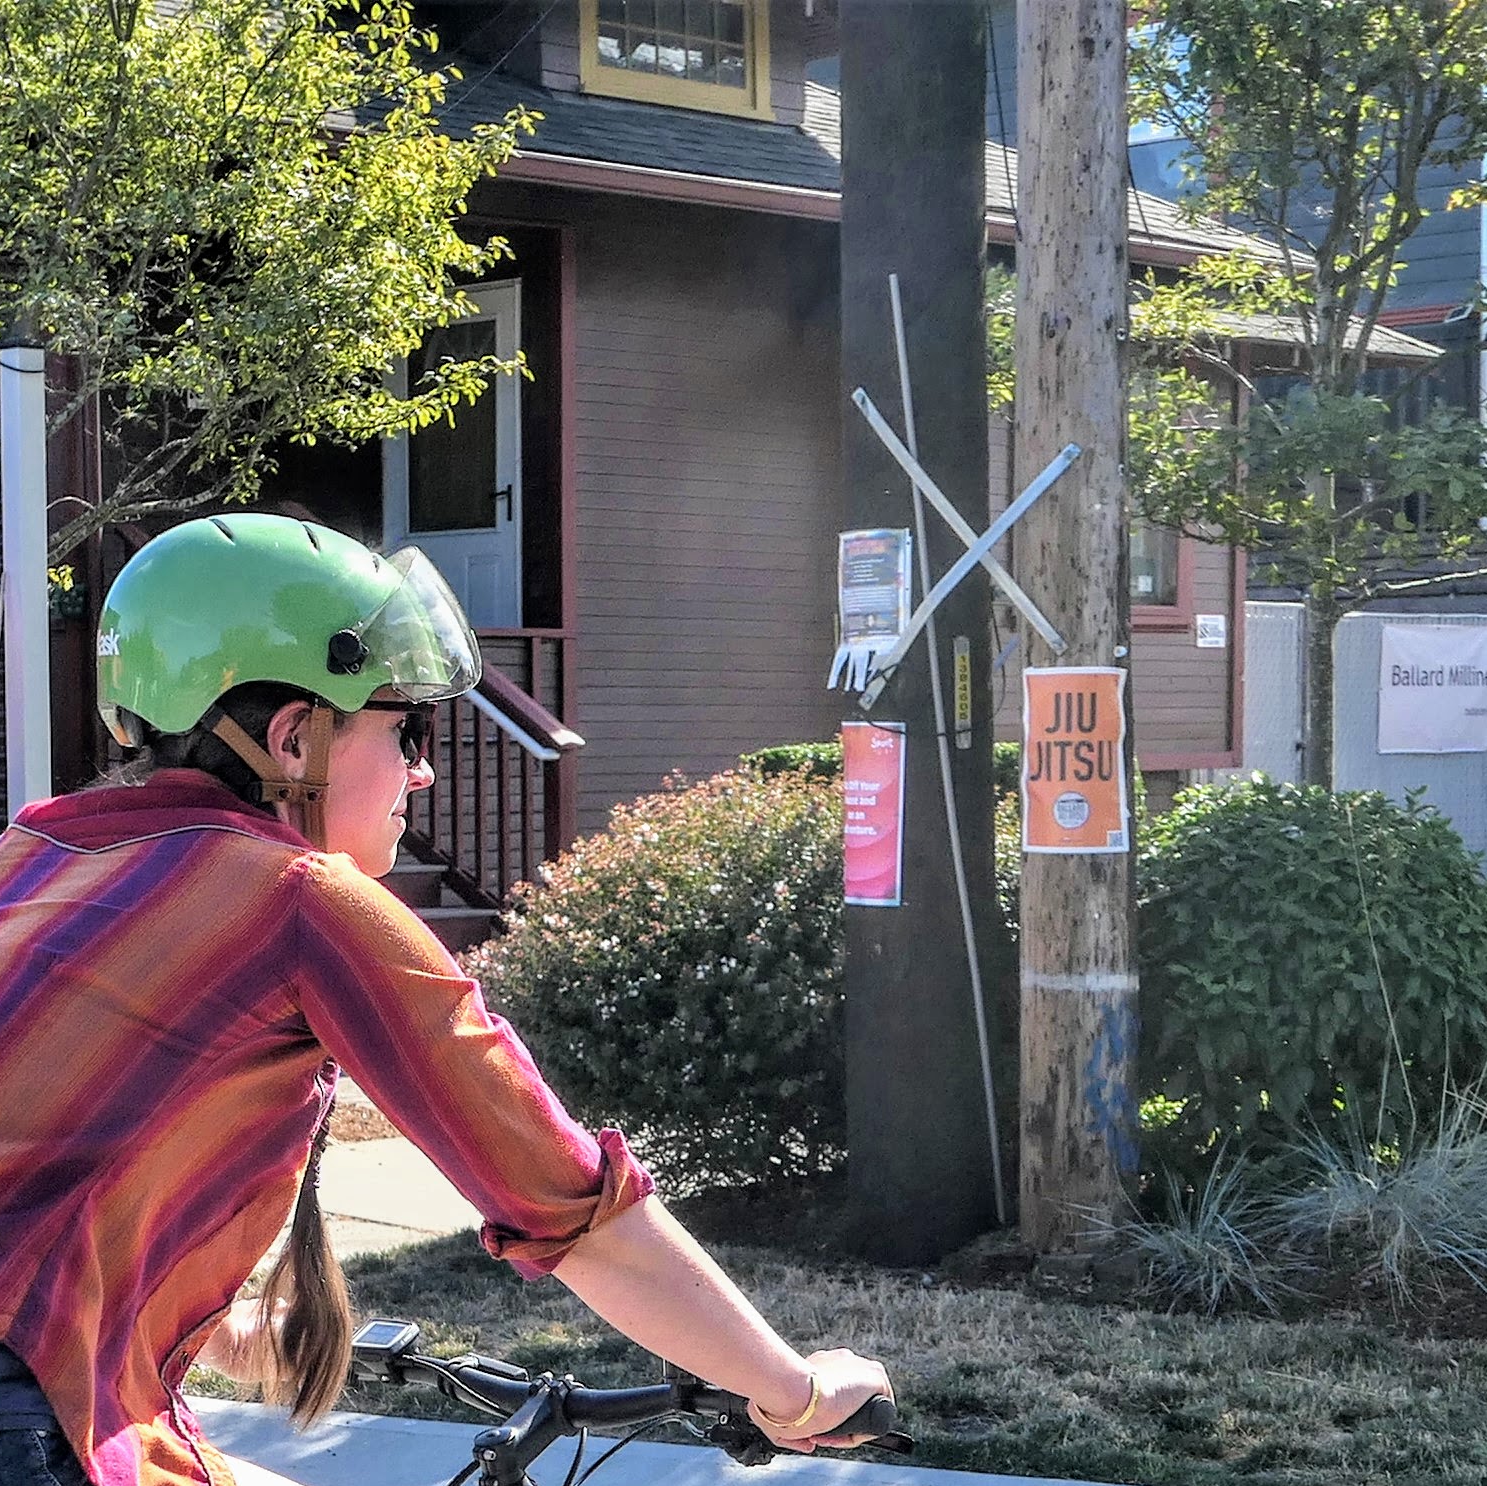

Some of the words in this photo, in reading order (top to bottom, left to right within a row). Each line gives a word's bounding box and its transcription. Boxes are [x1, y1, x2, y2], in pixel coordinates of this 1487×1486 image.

[1391, 664, 1444, 687] Ballard
[1045, 692, 1097, 734] JIU
[1030, 740, 1113, 782] JITSU
